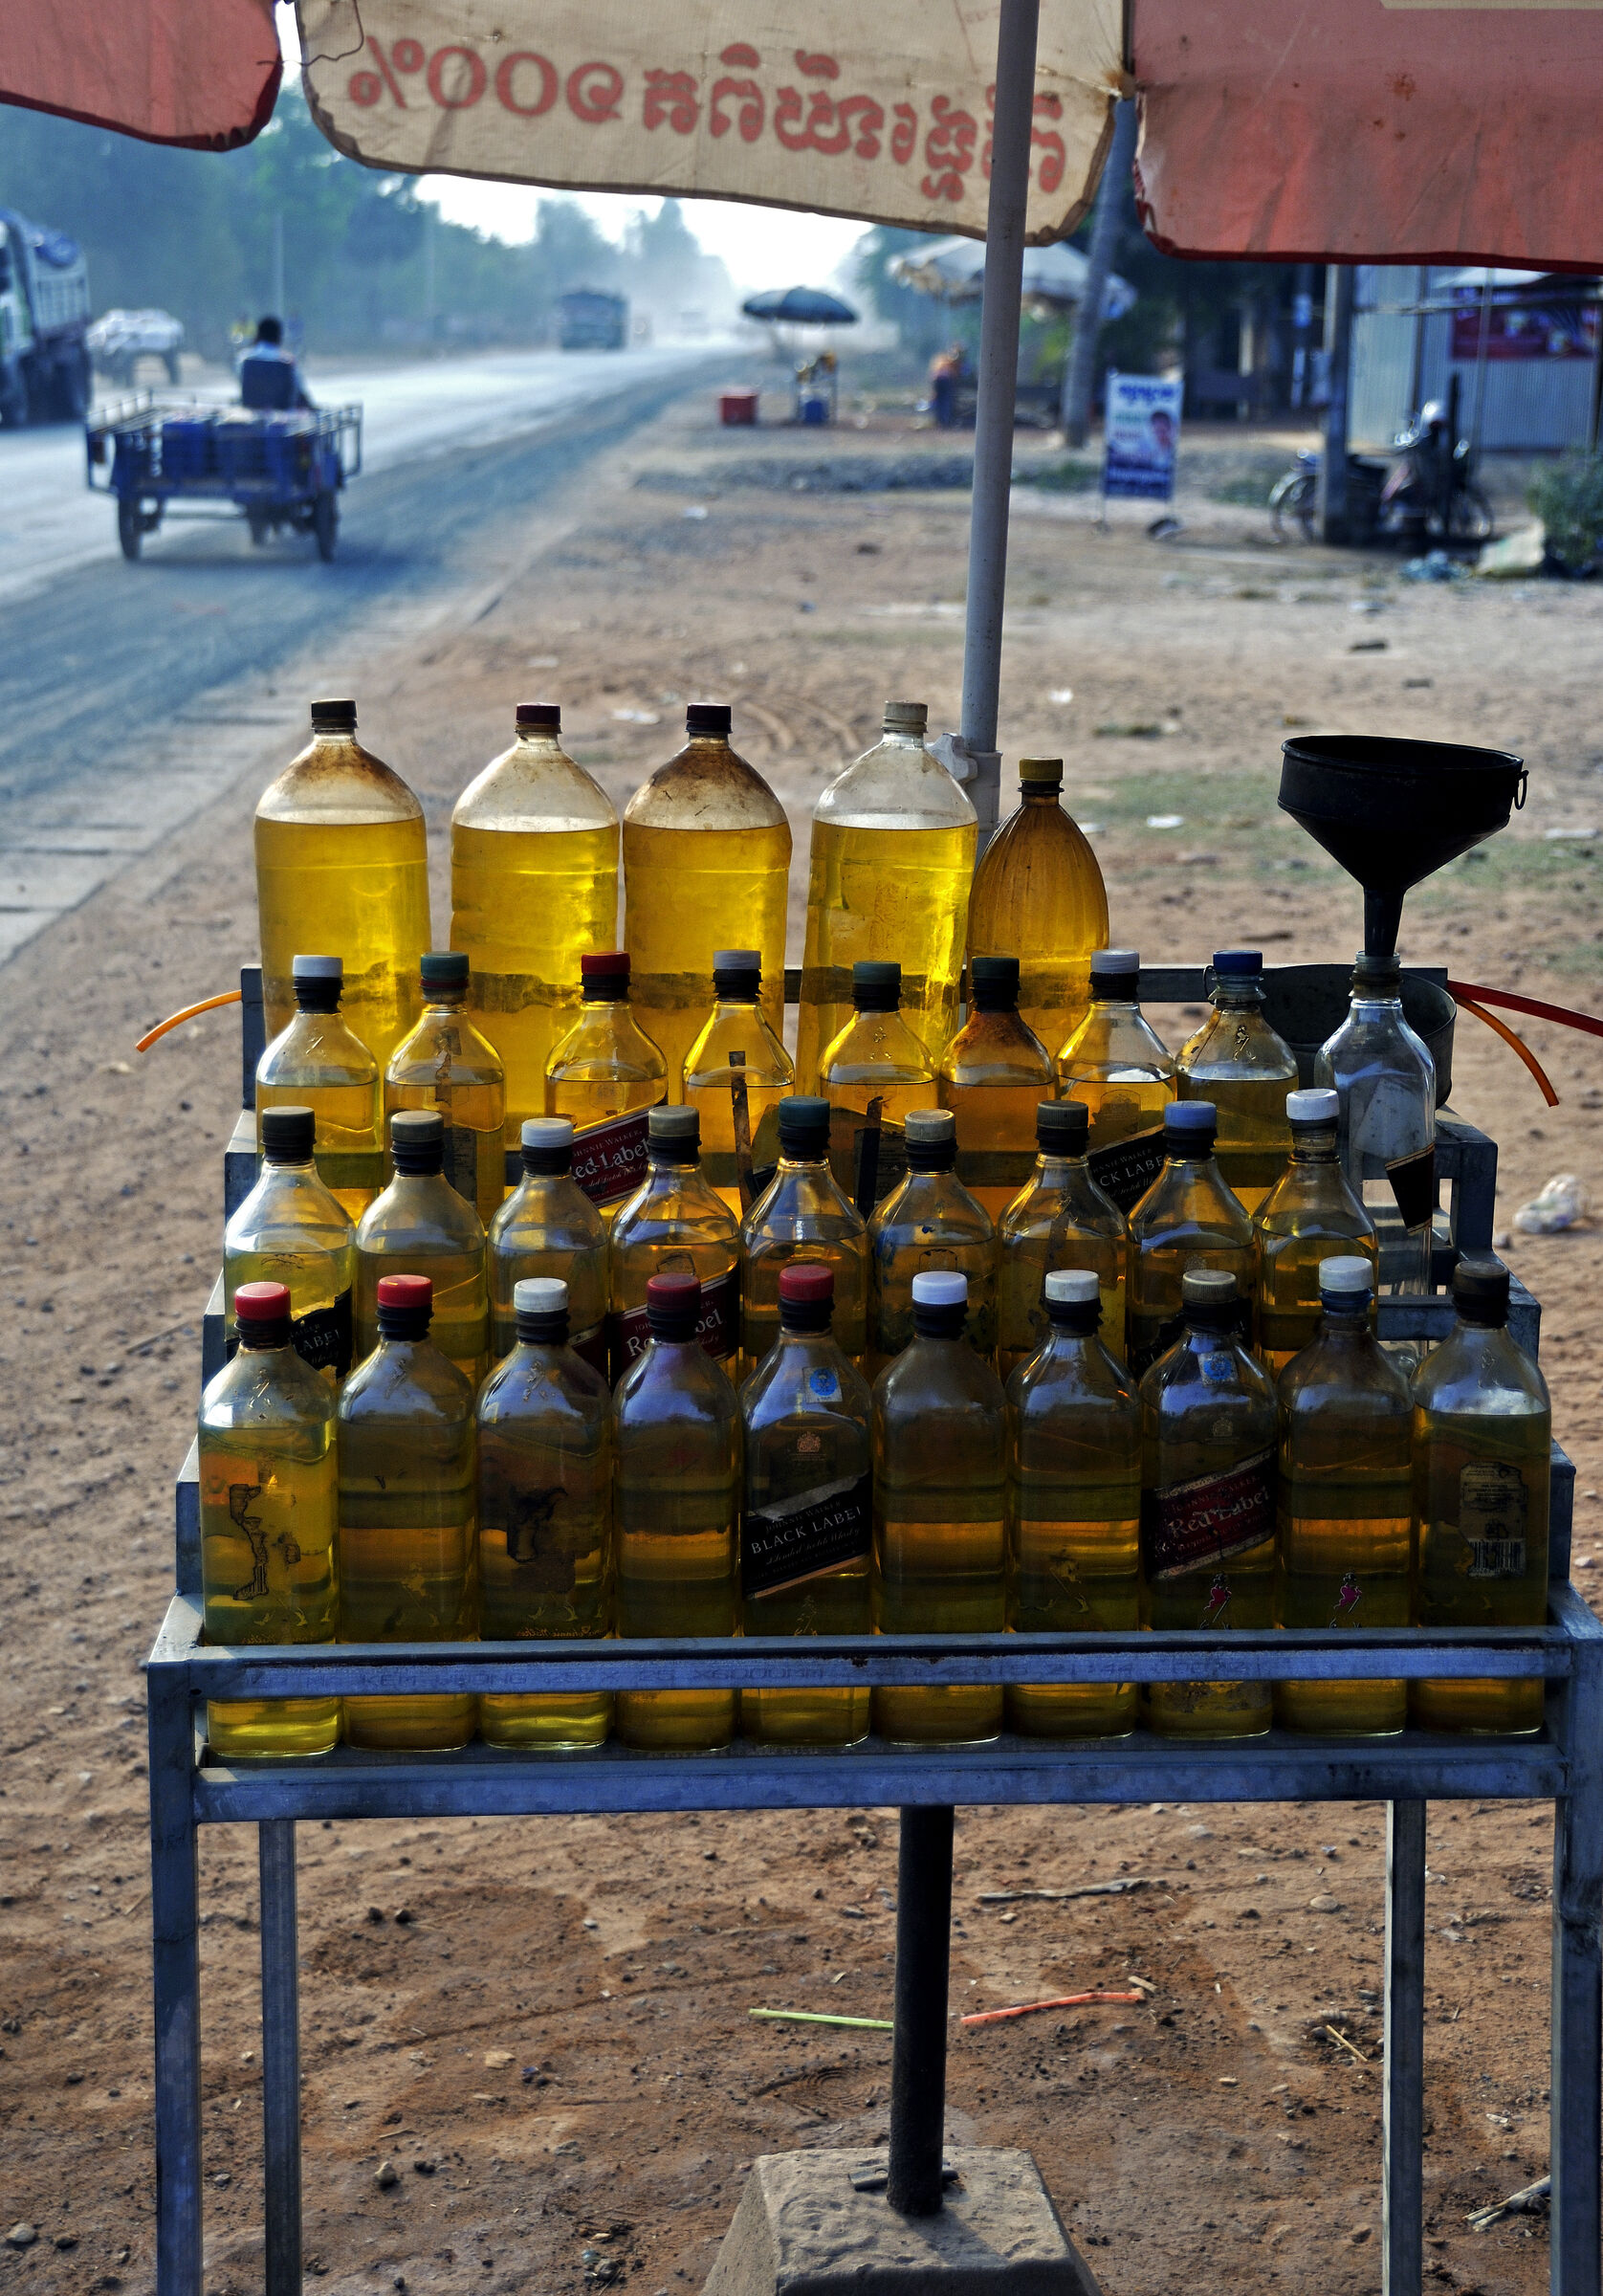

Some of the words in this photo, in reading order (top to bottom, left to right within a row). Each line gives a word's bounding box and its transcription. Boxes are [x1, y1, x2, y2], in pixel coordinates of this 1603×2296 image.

[573, 1157, 598, 1180] ed
[600, 1137, 650, 1169] Label
[1125, 1156, 1164, 1178] LABE
[751, 1525, 808, 1554] BLACK
[812, 1506, 862, 1533] LABEL
